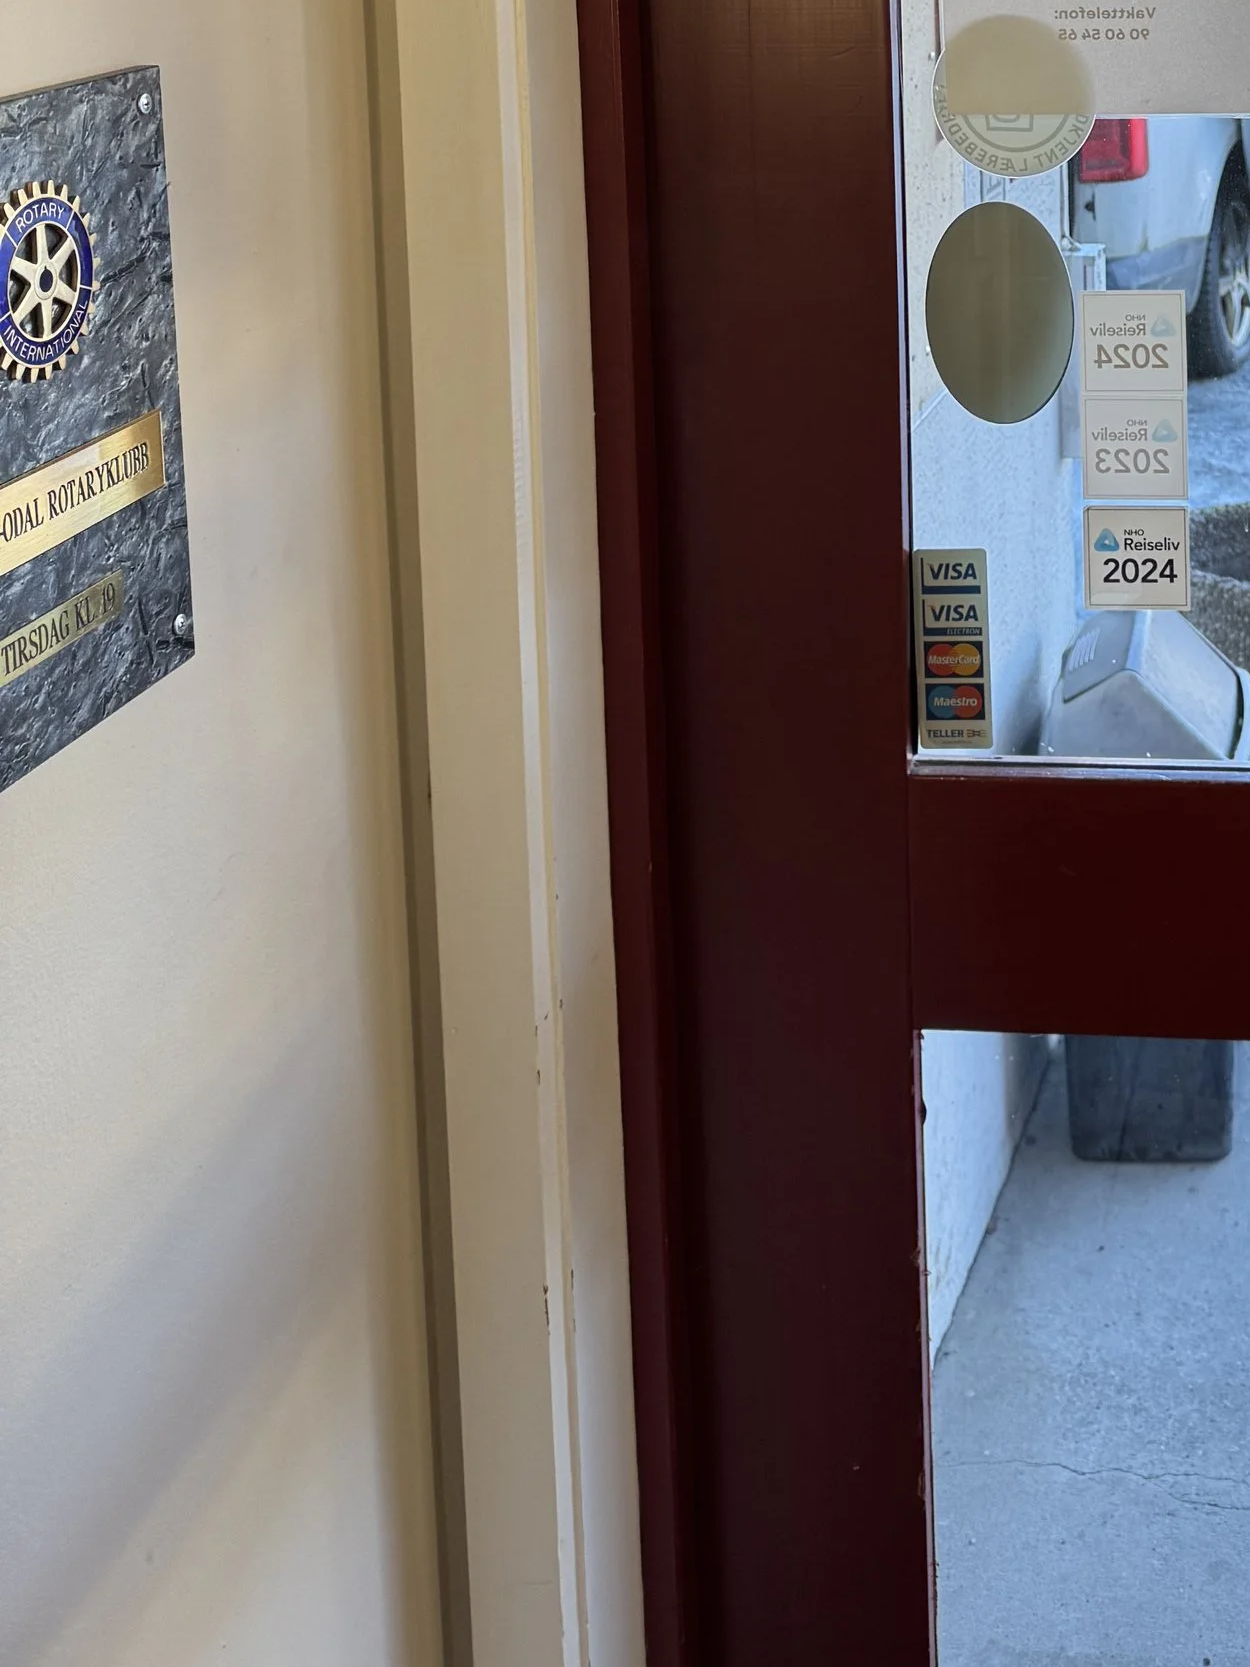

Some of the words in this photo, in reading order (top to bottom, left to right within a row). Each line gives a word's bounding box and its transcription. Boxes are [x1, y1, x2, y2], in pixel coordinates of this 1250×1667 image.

[15, 202, 65, 234] ROTARY
[3, 299, 88, 363] INTERNATIONAL
[48, 442, 149, 521] ROTARYKLUBB
[1123, 538, 1180, 552] Reiseliv
[929, 562, 977, 580] VISA
[1102, 558, 1178, 584] 2024
[930, 604, 979, 622] VISA
[1, 610, 70, 676] TIRSDAG
[101, 582, 115, 615] 19
[946, 627, 981, 635] ELECTRON
[928, 654, 981, 665] MasterCard
[933, 696, 977, 707] Maestro
[926, 729, 964, 738] TELLER
